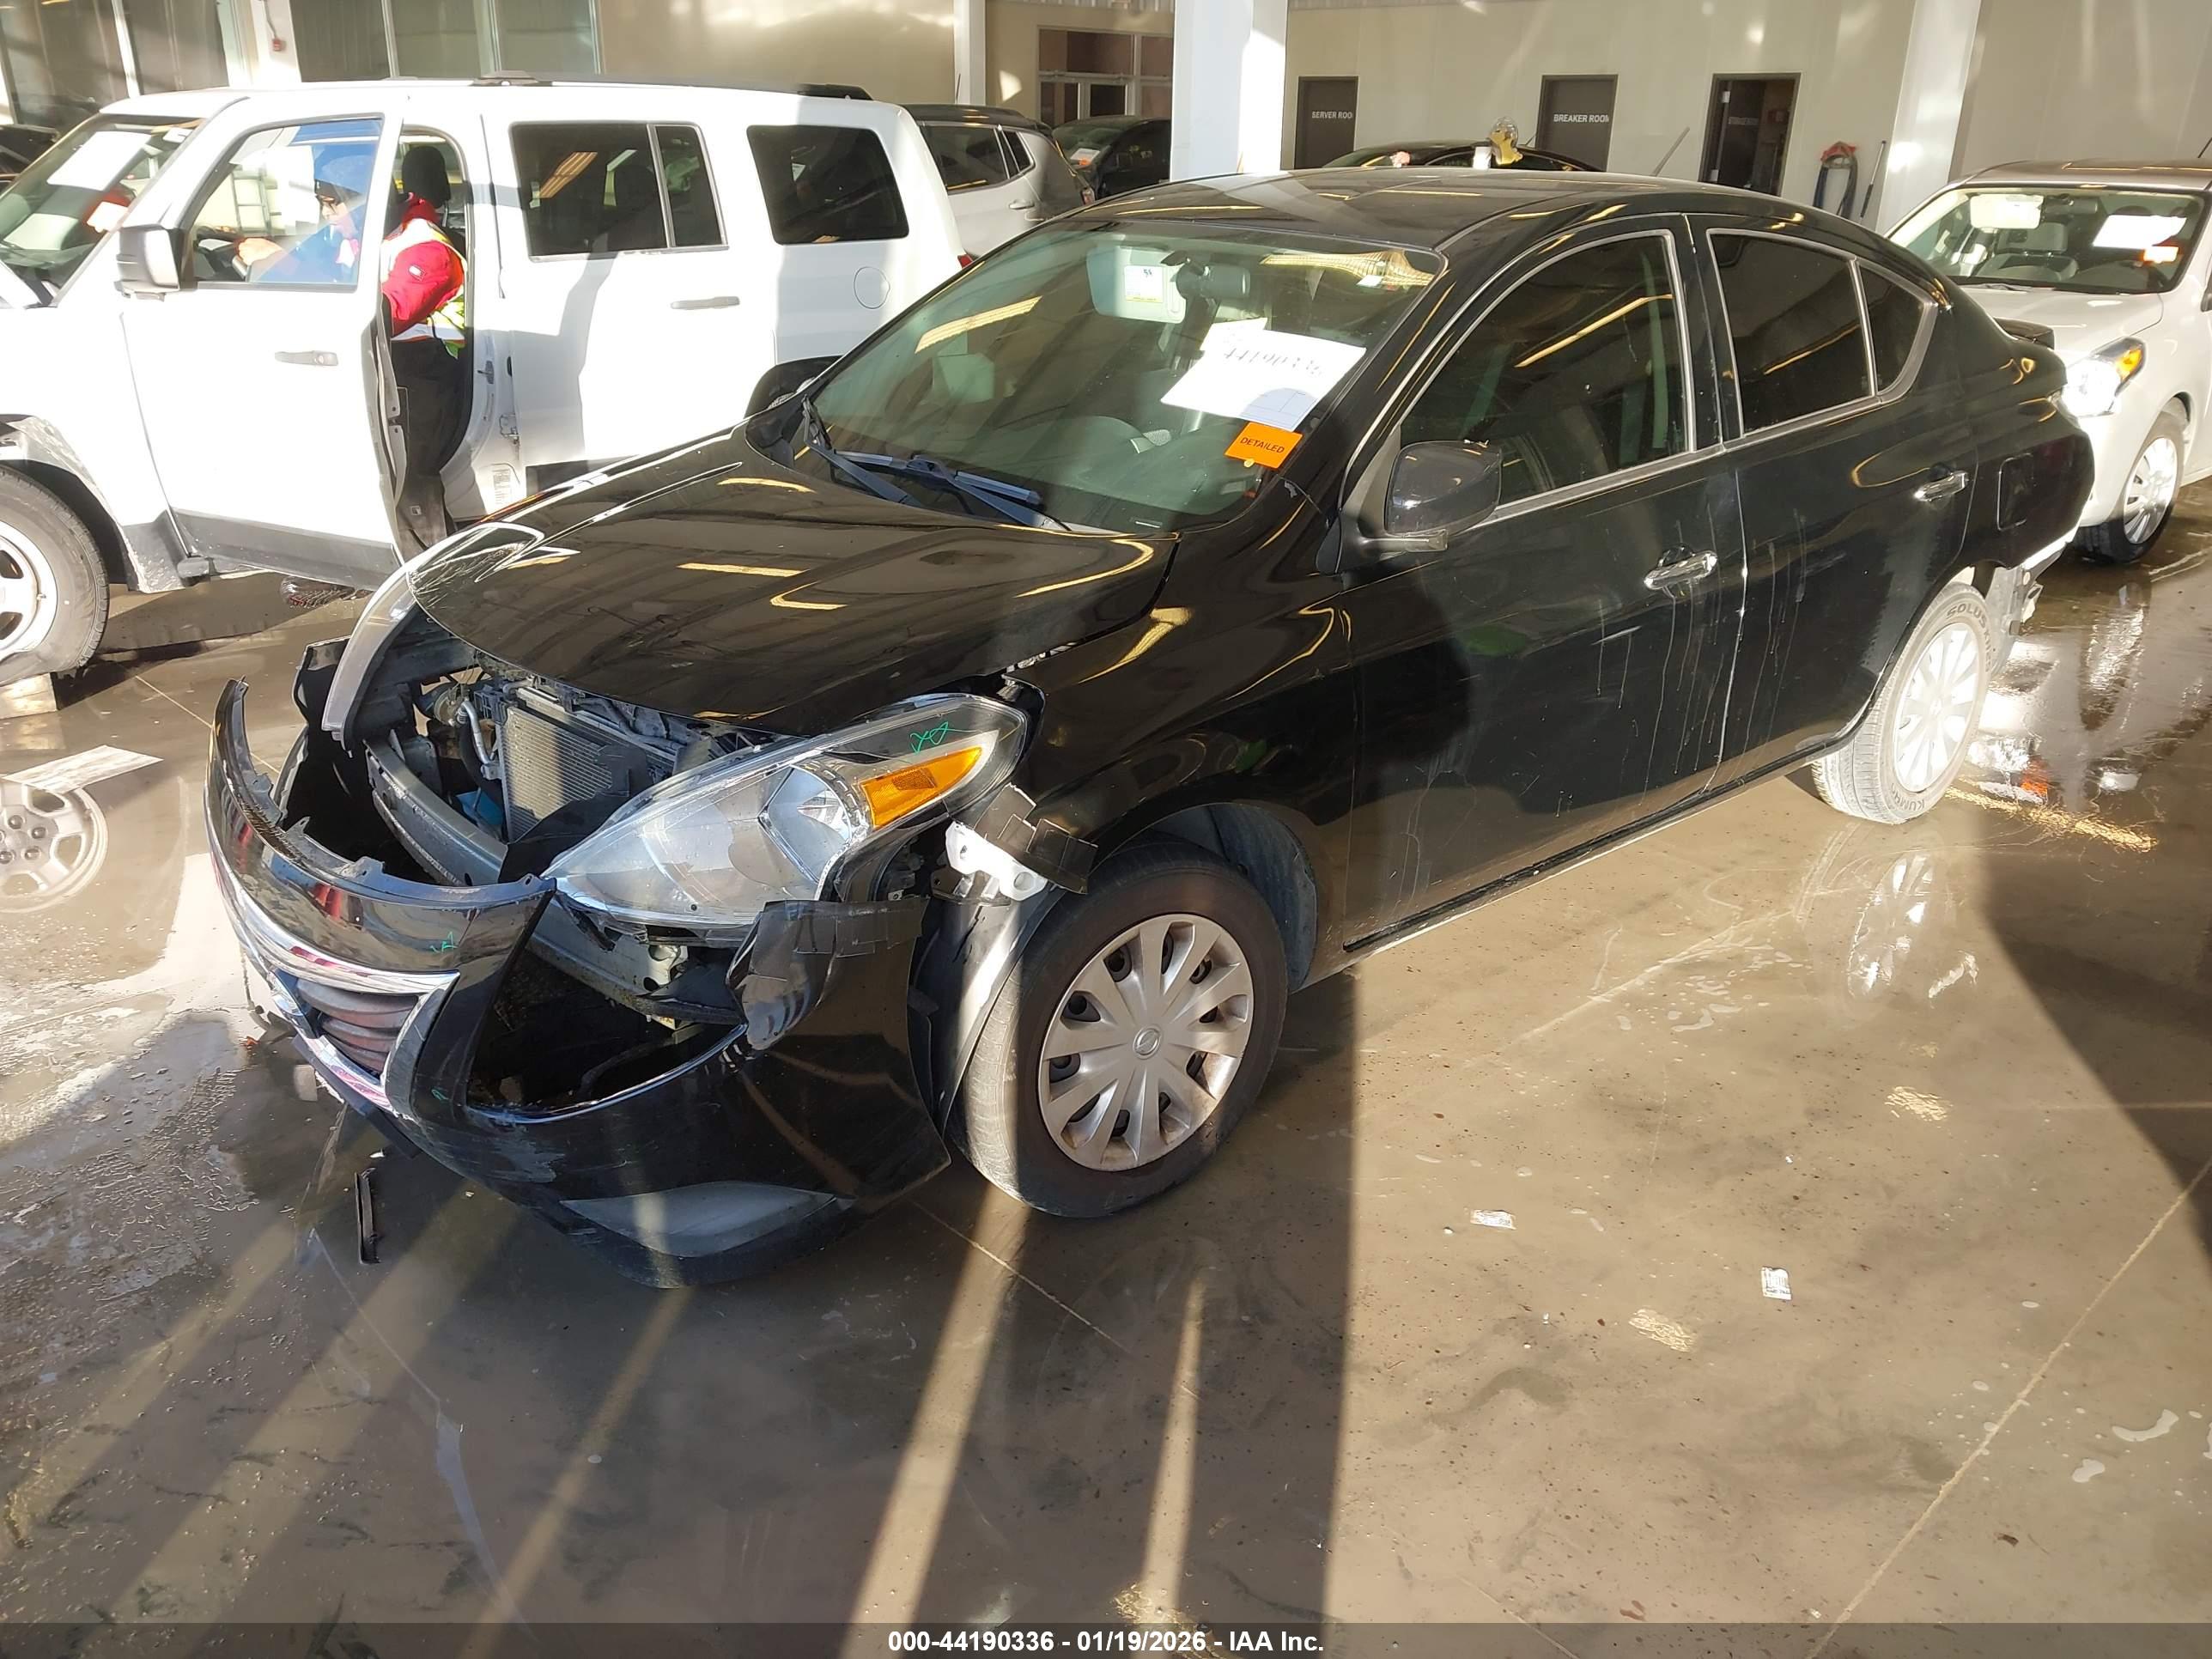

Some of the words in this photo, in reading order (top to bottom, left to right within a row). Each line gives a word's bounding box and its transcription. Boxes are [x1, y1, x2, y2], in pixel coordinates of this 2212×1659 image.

[1553, 113, 1588, 122] BREAKER
[1240, 436, 1285, 453] DETAILED
[1946, 603, 1988, 629] SOLUS
